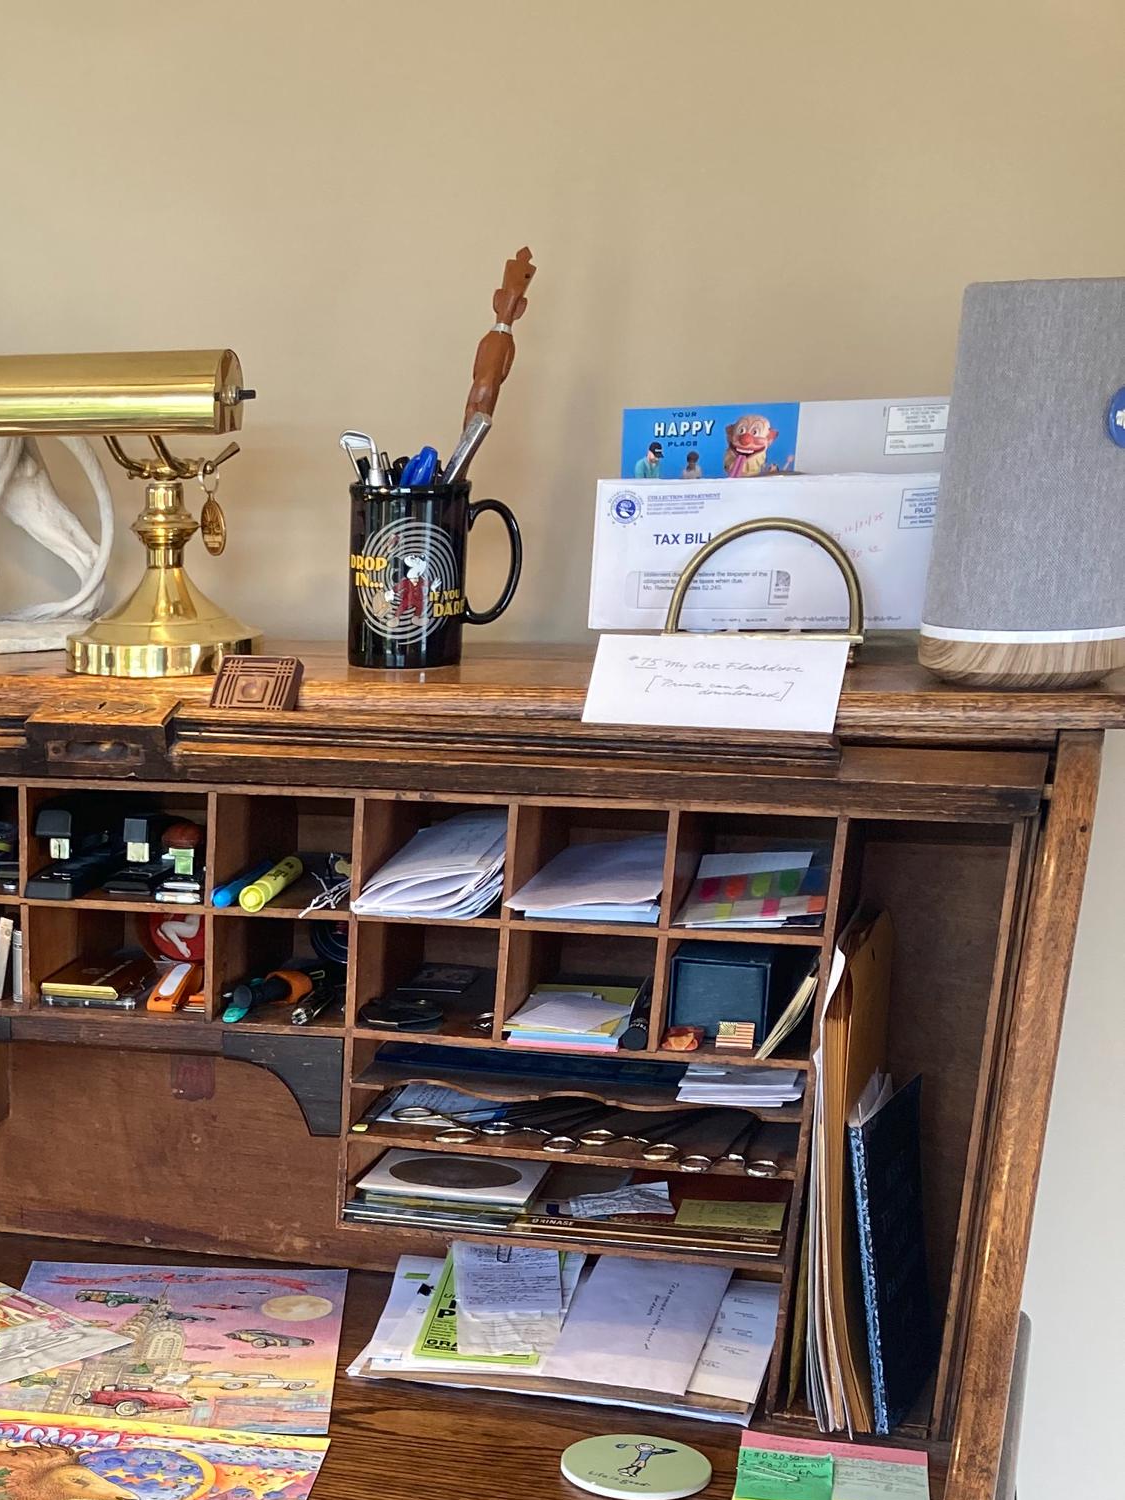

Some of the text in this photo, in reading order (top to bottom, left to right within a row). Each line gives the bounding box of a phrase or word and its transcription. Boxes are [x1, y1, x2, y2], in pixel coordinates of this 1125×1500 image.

[653, 420, 716, 438] HAPPY
[653, 533, 680, 545] TAX
[350, 554, 388, 571] DROP
[429, 588, 460, 602] IF YOU
[433, 599, 466, 617] DARE
[588, 1470, 608, 1479] Life
